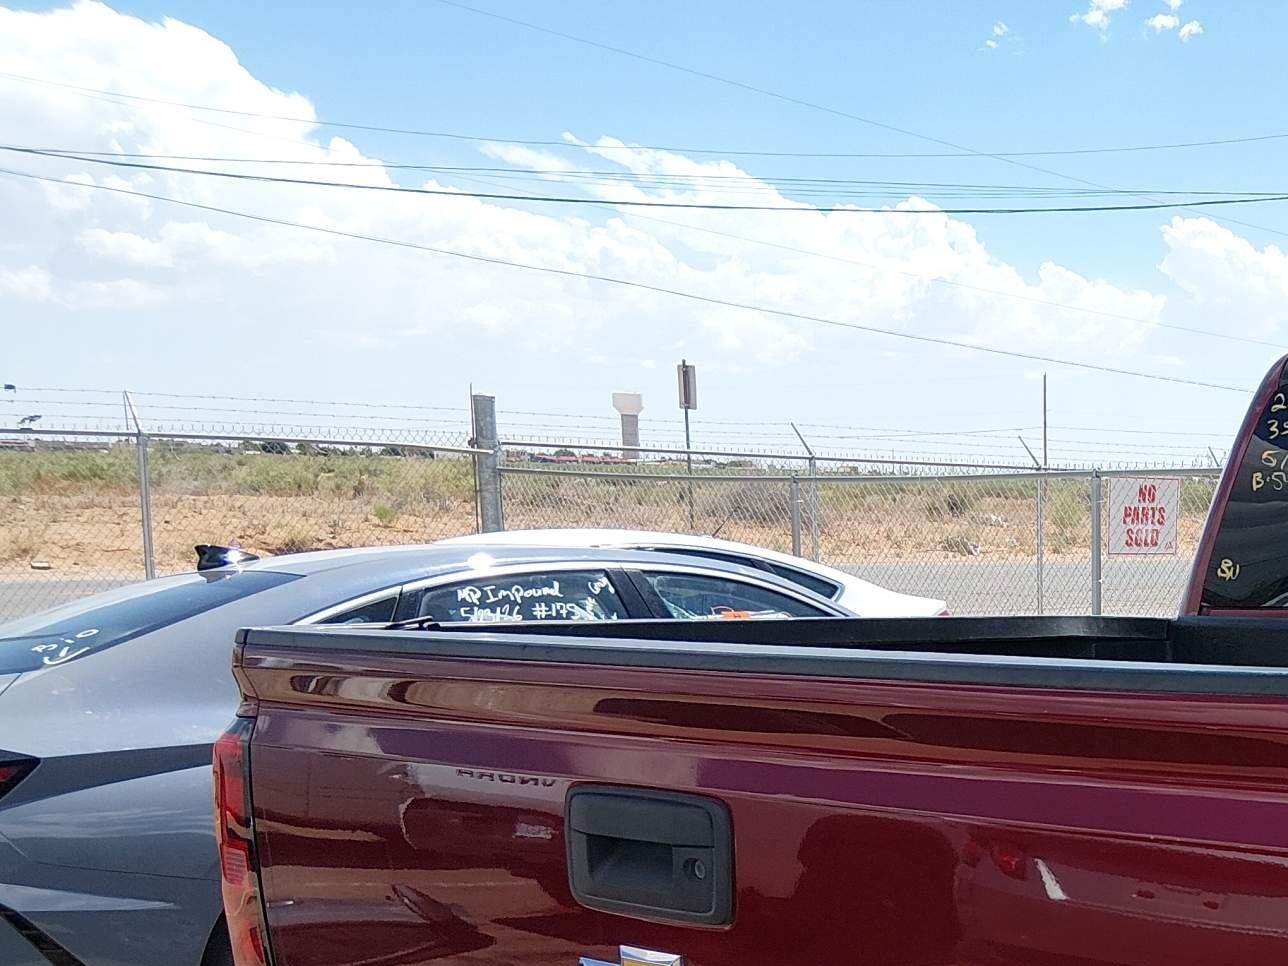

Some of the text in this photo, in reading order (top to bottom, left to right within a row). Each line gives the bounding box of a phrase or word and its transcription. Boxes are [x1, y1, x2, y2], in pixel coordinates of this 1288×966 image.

[1138, 484, 1157, 503] NO
[1122, 506, 1166, 526] PARTS
[1125, 528, 1159, 548] SOLD
